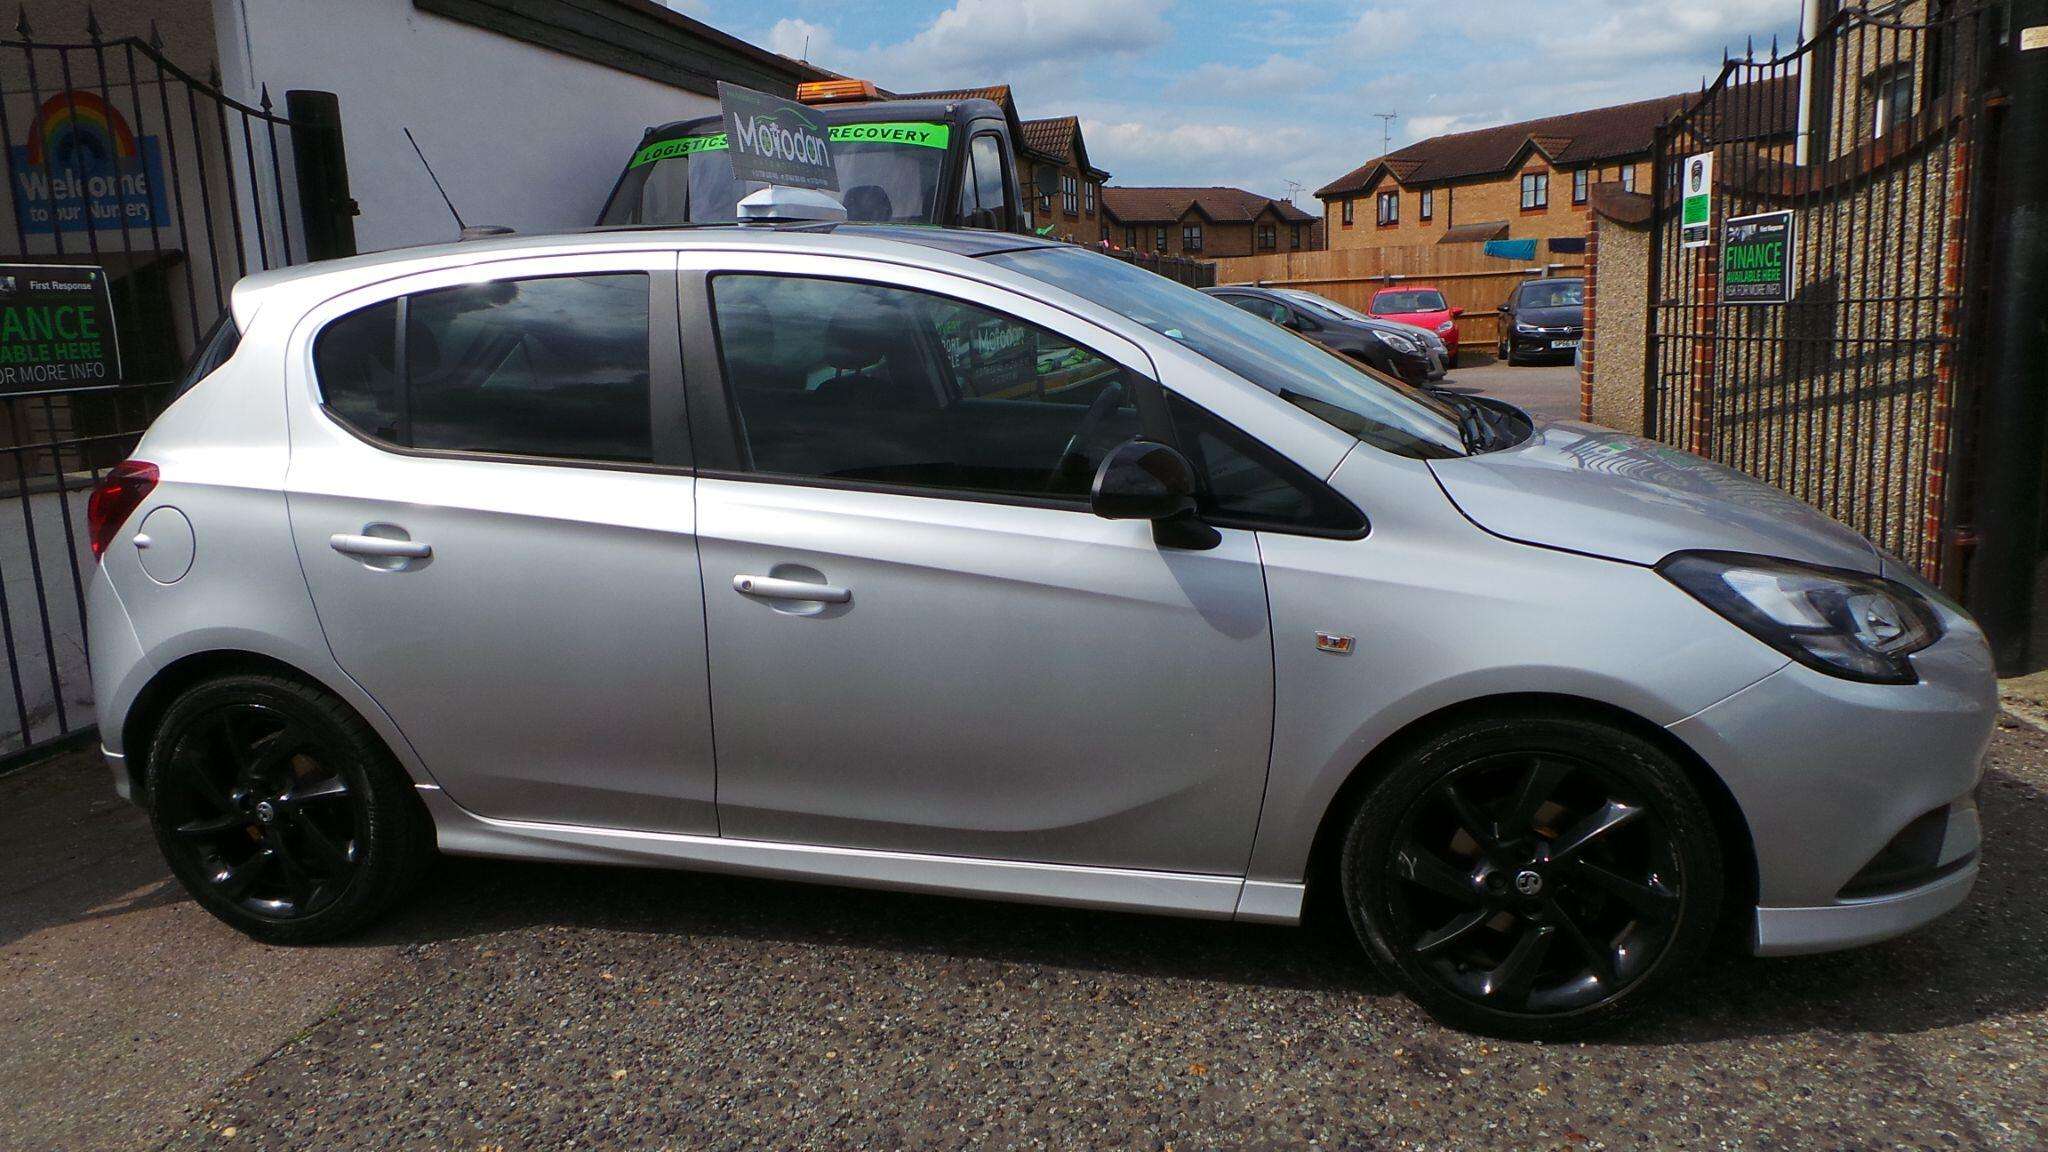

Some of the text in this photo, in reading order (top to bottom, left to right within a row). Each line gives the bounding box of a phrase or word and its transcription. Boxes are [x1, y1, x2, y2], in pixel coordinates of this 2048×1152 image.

[644, 127, 930, 161] LOGISTICS RECOVERY
[733, 112, 830, 168] Motodan
[19, 168, 148, 201] Welome
[30, 206, 48, 222] to
[54, 205, 81, 221] ur
[1726, 242, 1782, 270] FINANCE
[30, 281, 92, 292] First Response
[2, 305, 101, 341] ANCE
[55, 342, 102, 360] HERE
[20, 364, 69, 383] MORE
[71, 361, 105, 380] INFO
